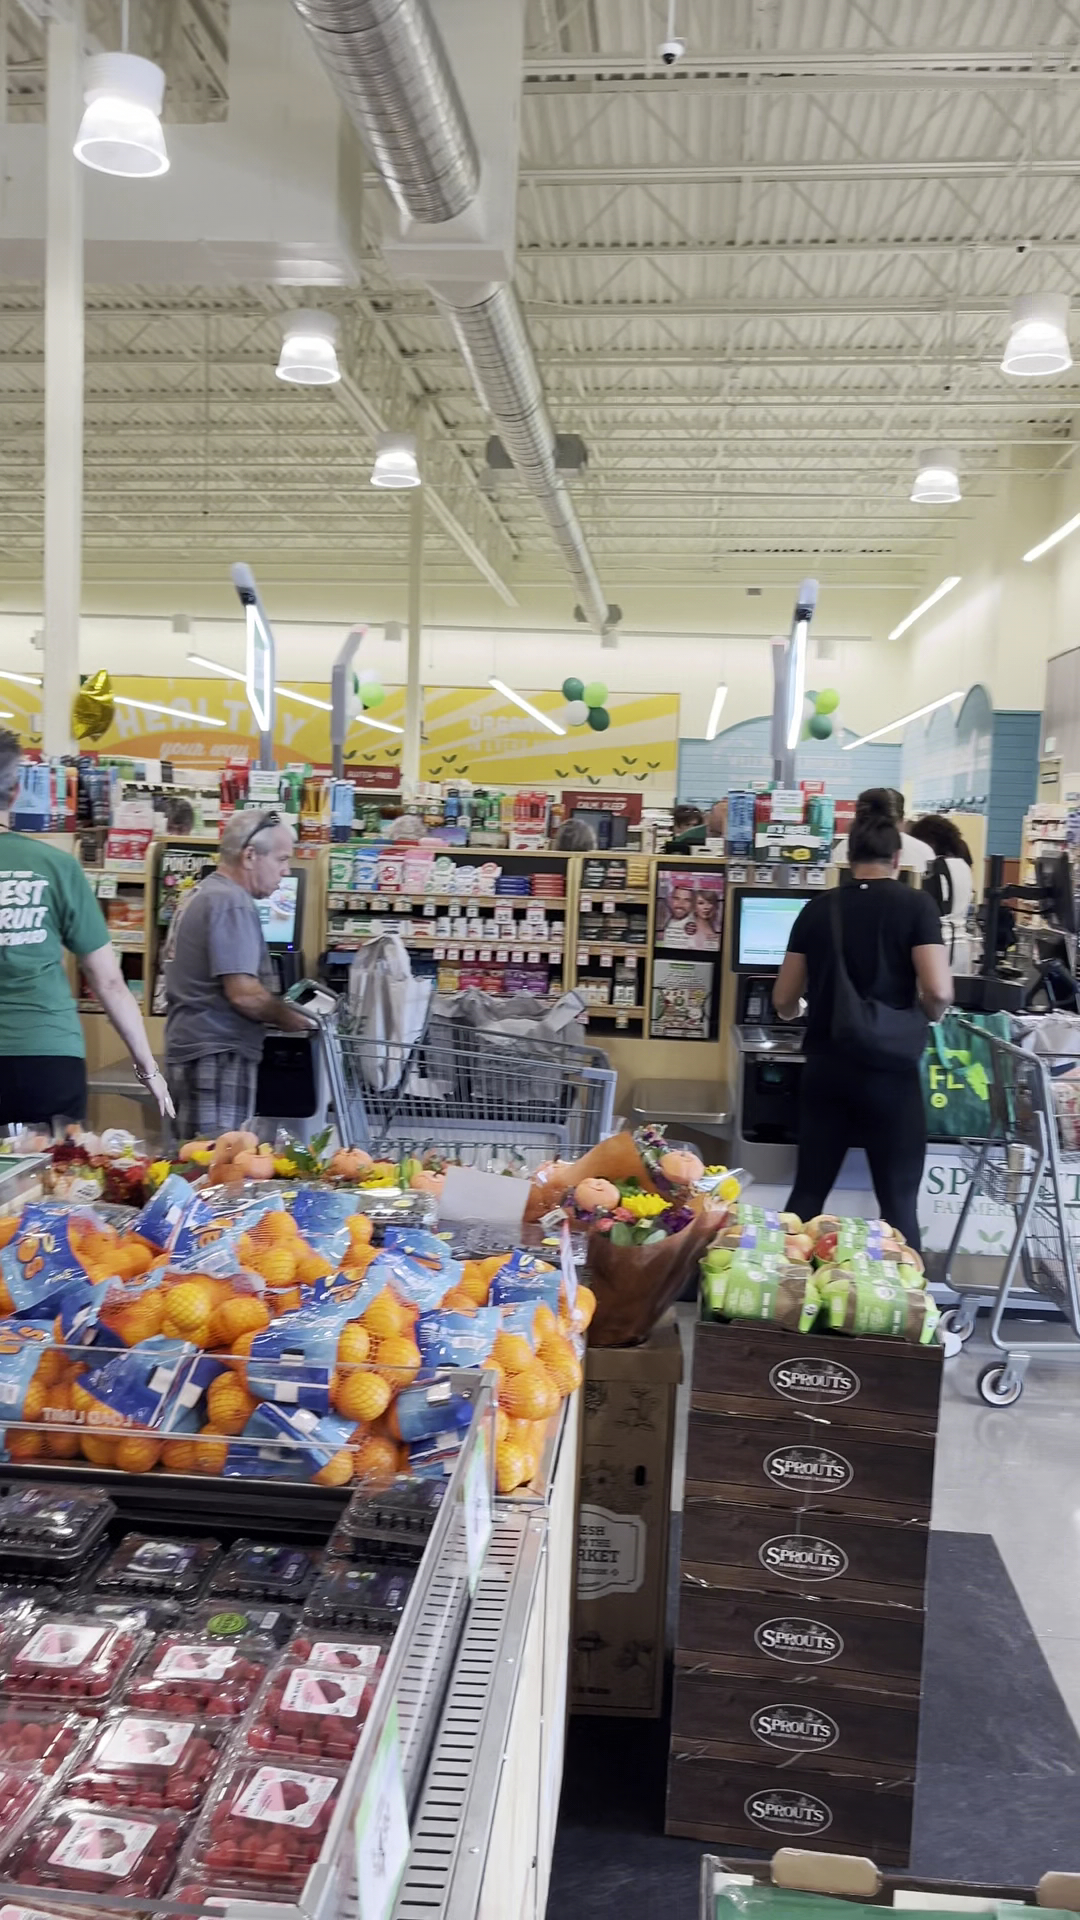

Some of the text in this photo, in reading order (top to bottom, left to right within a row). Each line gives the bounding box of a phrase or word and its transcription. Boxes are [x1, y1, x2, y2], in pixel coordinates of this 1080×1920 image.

[929, 1064, 965, 1089] FL
[776, 1369, 852, 1390] SPROUTS
[770, 1458, 846, 1478] SPROUTS
[766, 1546, 840, 1567] SPROUTS
[761, 1629, 836, 1650] SPROUTS
[757, 1716, 831, 1738] SPROUTS
[751, 1801, 824, 1822] SPROUTS
